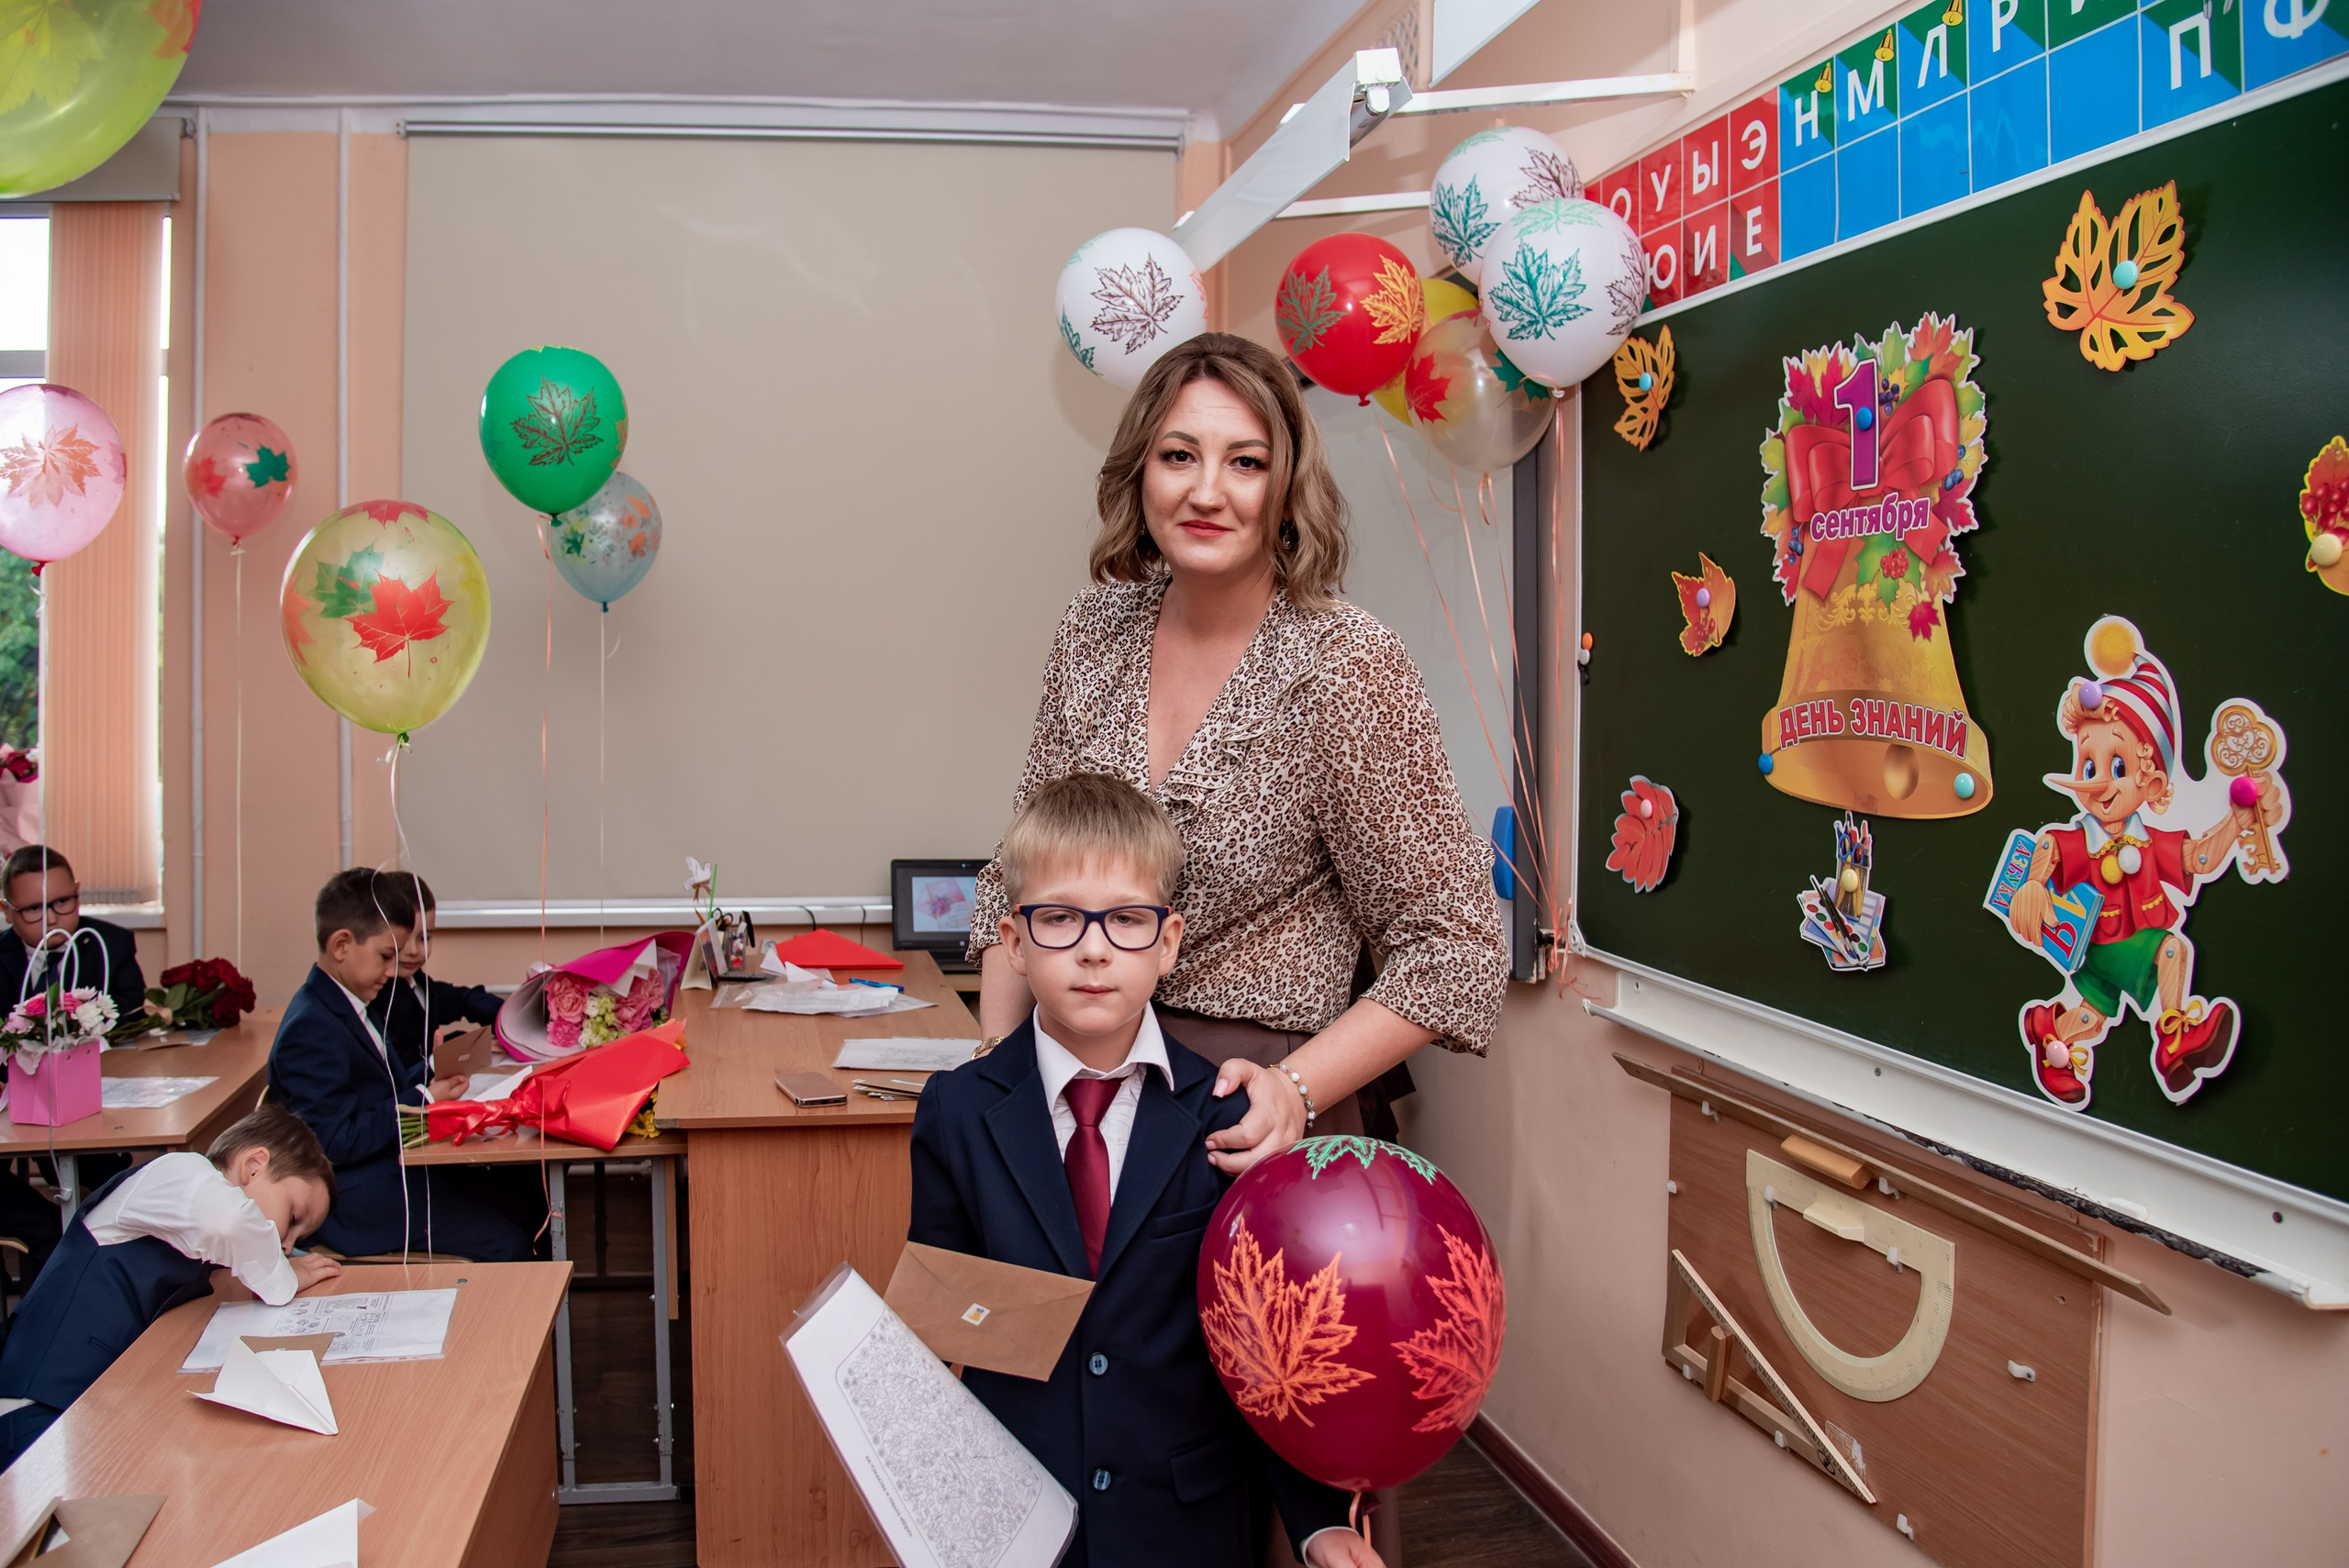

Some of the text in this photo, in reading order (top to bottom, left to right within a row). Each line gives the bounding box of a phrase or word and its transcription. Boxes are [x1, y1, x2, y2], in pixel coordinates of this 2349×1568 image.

[1644, 243, 1677, 296] Ю
[1693, 224, 1717, 275] И
[1746, 205, 1762, 257] Е
[2169, 11, 2211, 91] П
[1650, 163, 1672, 212] У
[1692, 140, 1719, 195] Ы
[1741, 119, 1767, 170] Э
[1794, 89, 1819, 147] Н
[1847, 58, 1885, 121] М
[1917, 23, 1947, 89] Л
[1991, 0, 2019, 53] Р
[1834, 357, 1879, 491] 1
[1810, 492, 1931, 541] сентября
[1778, 697, 1968, 761] ДЕНЬ ЗНАНИЙ
[1993, 840, 2032, 909] АЗБУКА
